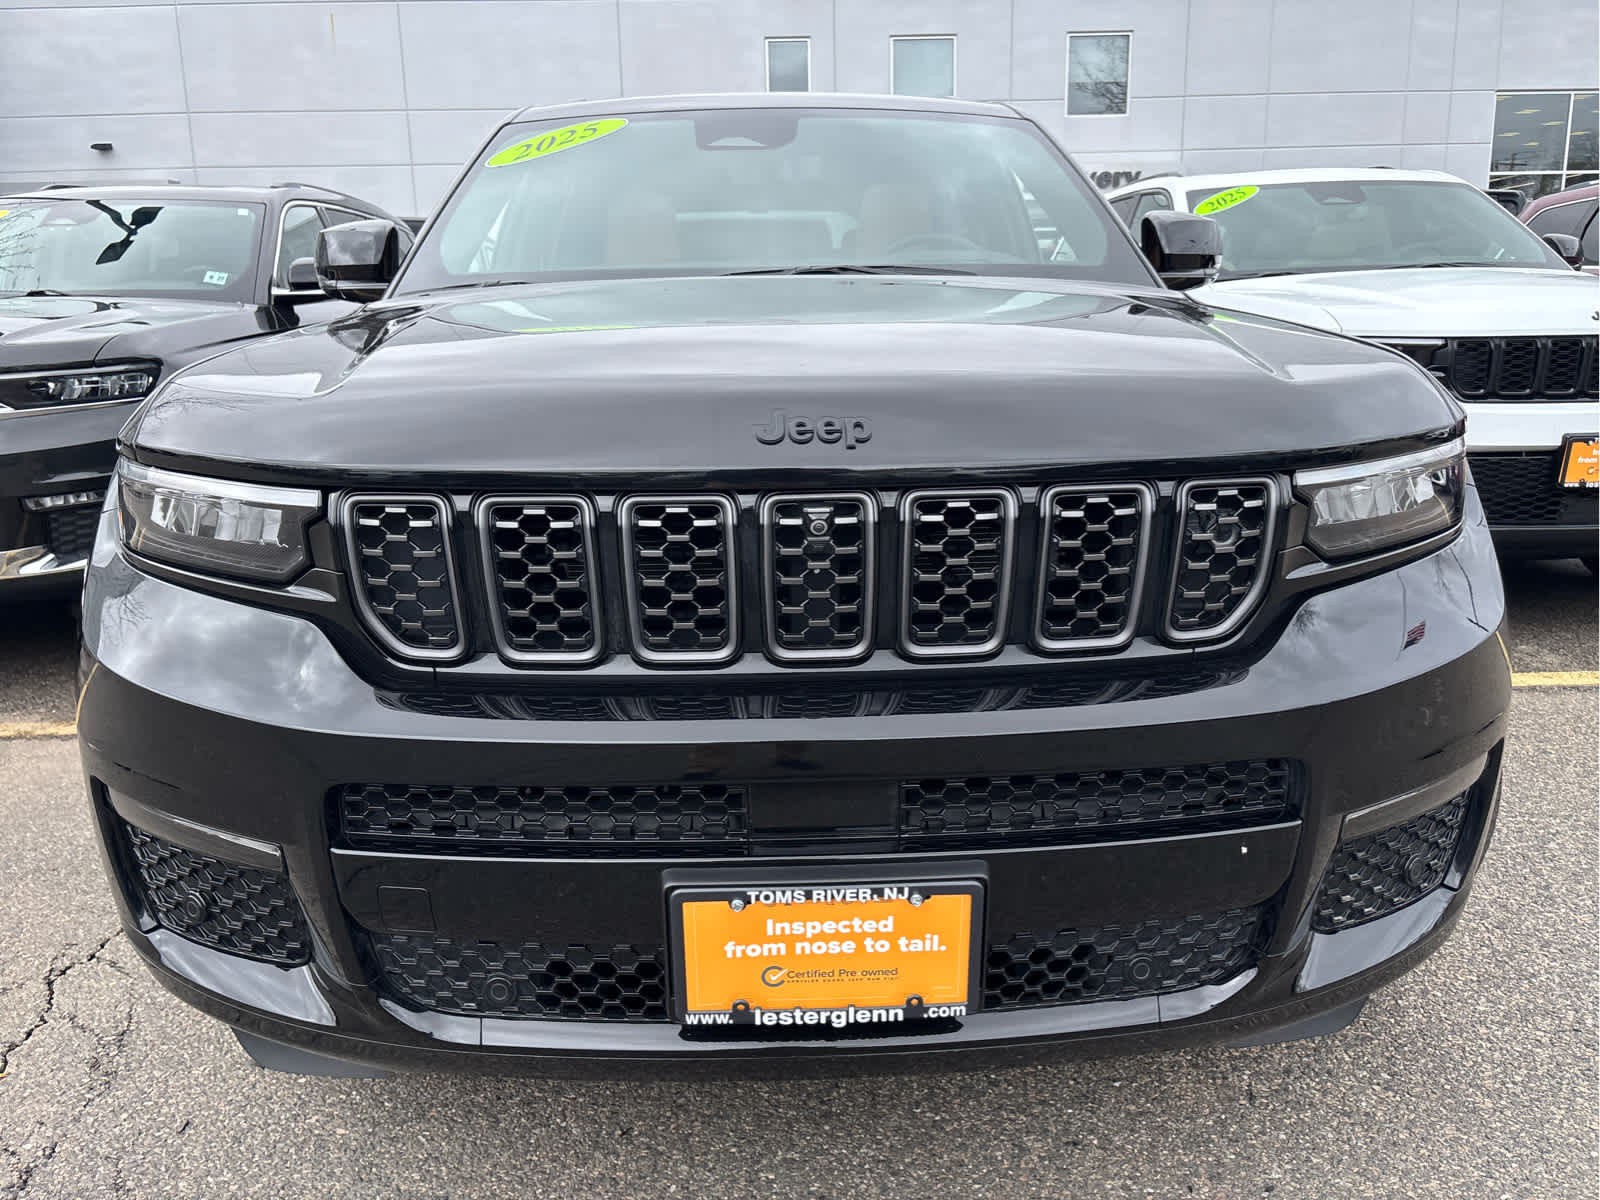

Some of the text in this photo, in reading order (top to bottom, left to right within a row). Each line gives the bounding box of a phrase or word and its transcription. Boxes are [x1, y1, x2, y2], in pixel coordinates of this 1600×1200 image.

[512, 122, 601, 161] 2025
[1206, 187, 1249, 213] 2025
[752, 408, 872, 450] Jeep
[747, 887, 909, 905] TOMS RIVER, NJ
[766, 916, 894, 938] Inspected
[724, 934, 947, 958] from nose to tail.
[786, 969, 835, 979] Certified
[685, 1005, 967, 1028] www. lesterglenn .com
